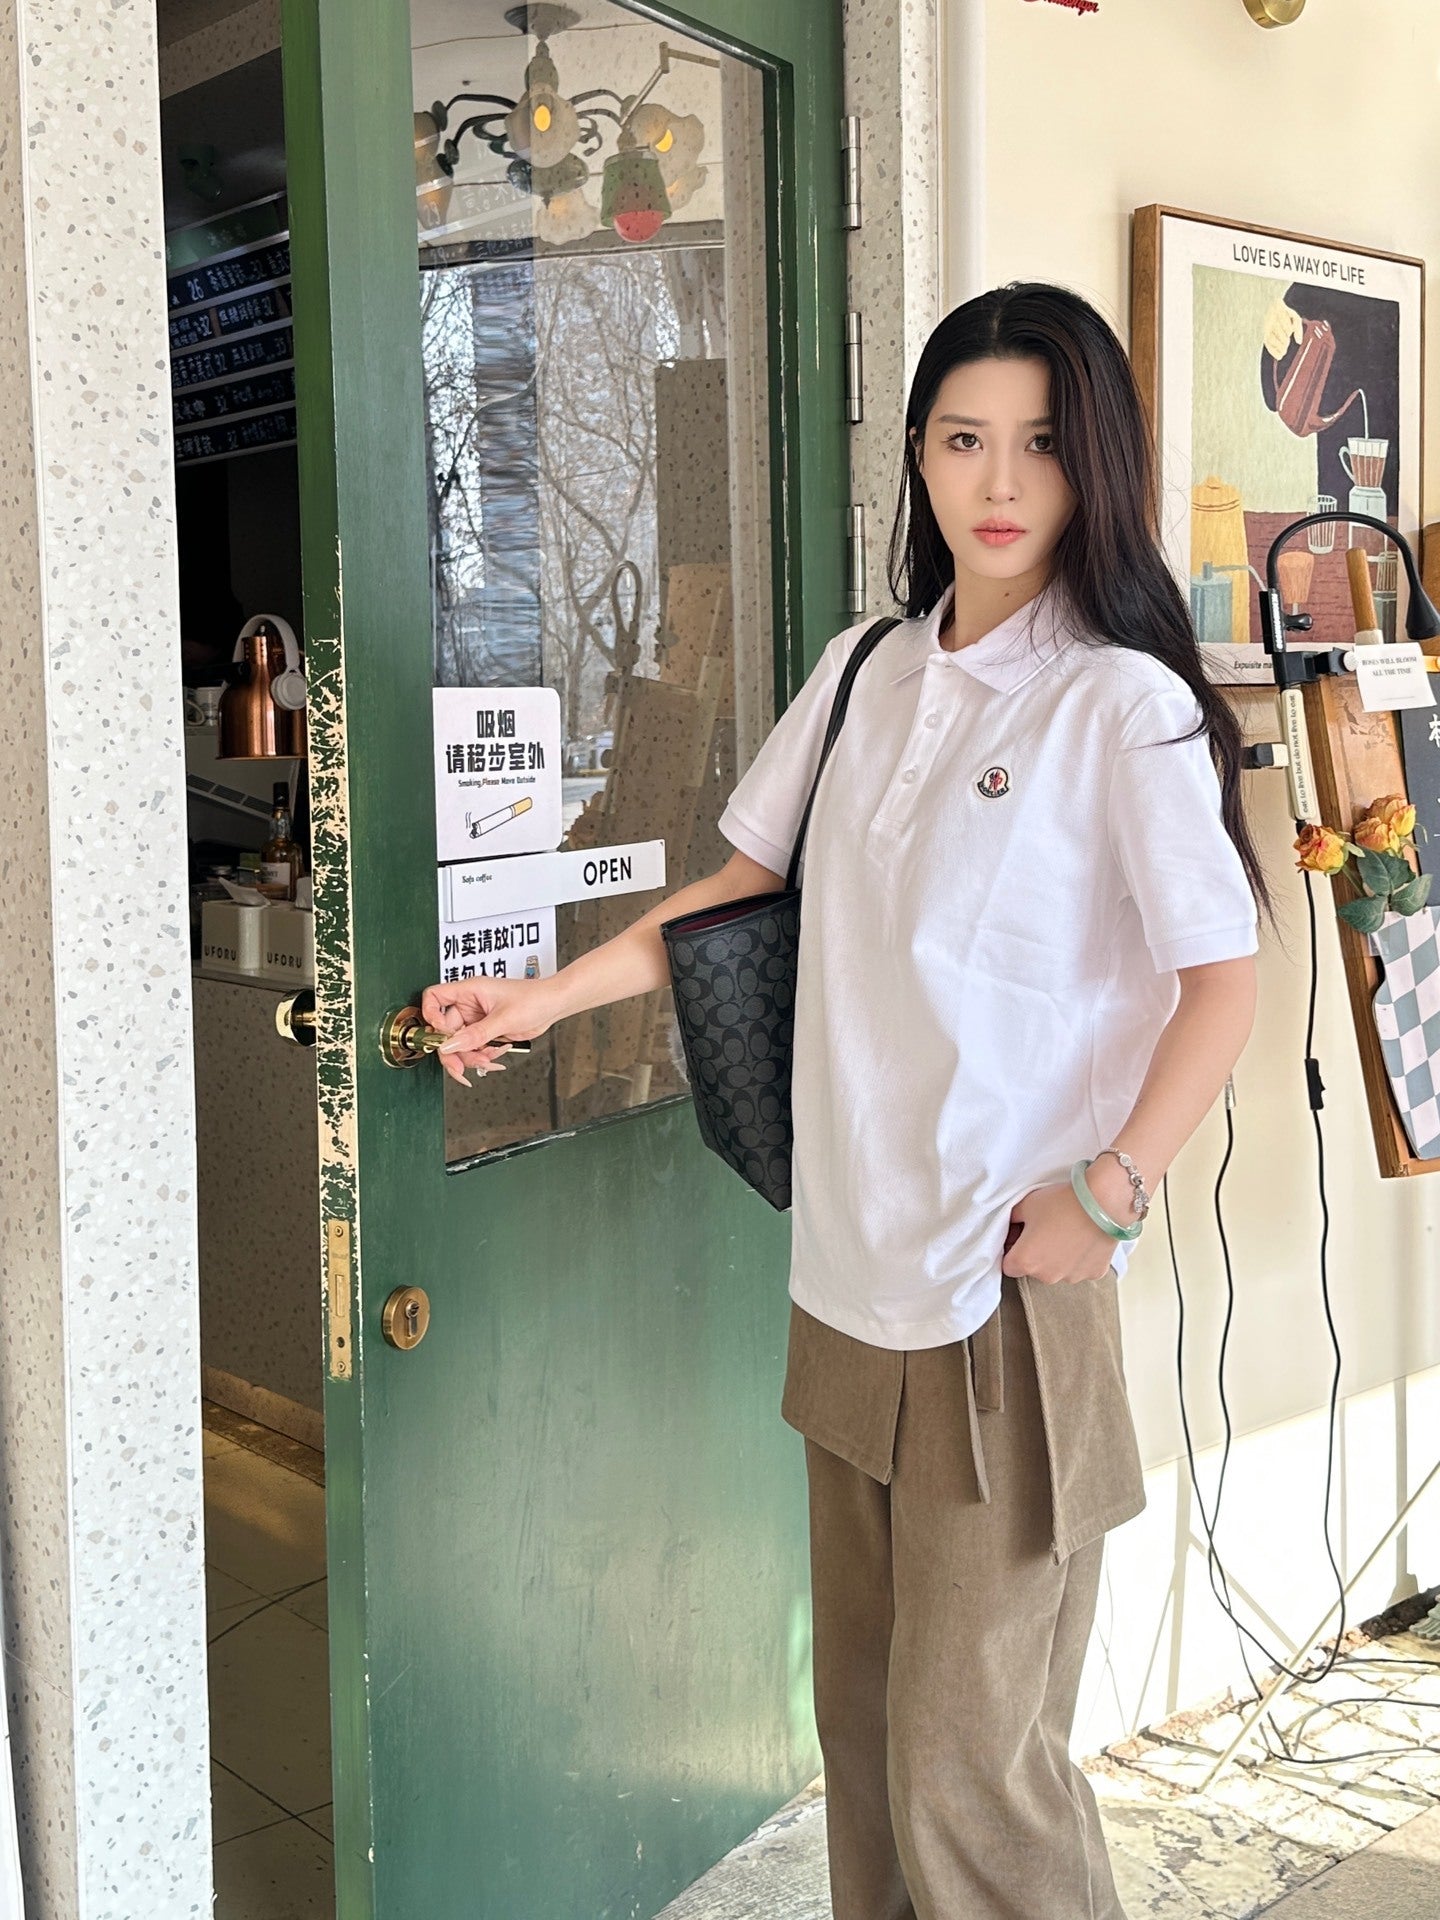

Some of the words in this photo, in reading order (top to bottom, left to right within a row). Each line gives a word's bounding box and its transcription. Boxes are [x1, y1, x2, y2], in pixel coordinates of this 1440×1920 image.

[1233, 243, 1266, 267] LOVE
[1269, 250, 1281, 268] IS
[1283, 253, 1292, 270] A
[1293, 254, 1320, 276] WAY
[1322, 260, 1338, 278] OF
[1340, 263, 1365, 286] LIFE
[187, 277, 205, 301] 26
[1289, 708, 1297, 718] to
[476, 709, 515, 739] 吸烟
[1290, 719, 1298, 733] live
[1291, 734, 1300, 748] not
[445, 741, 546, 774] 请移步室外
[1293, 748, 1301, 760] do
[1295, 761, 1303, 775] but
[1297, 776, 1306, 789] live
[1300, 789, 1307, 799] to
[583, 856, 632, 886] OPEN
[444, 921, 540, 961] 外卖请放门口
[204, 945, 237, 961] UFORU
[267, 951, 303, 968] UFORU
